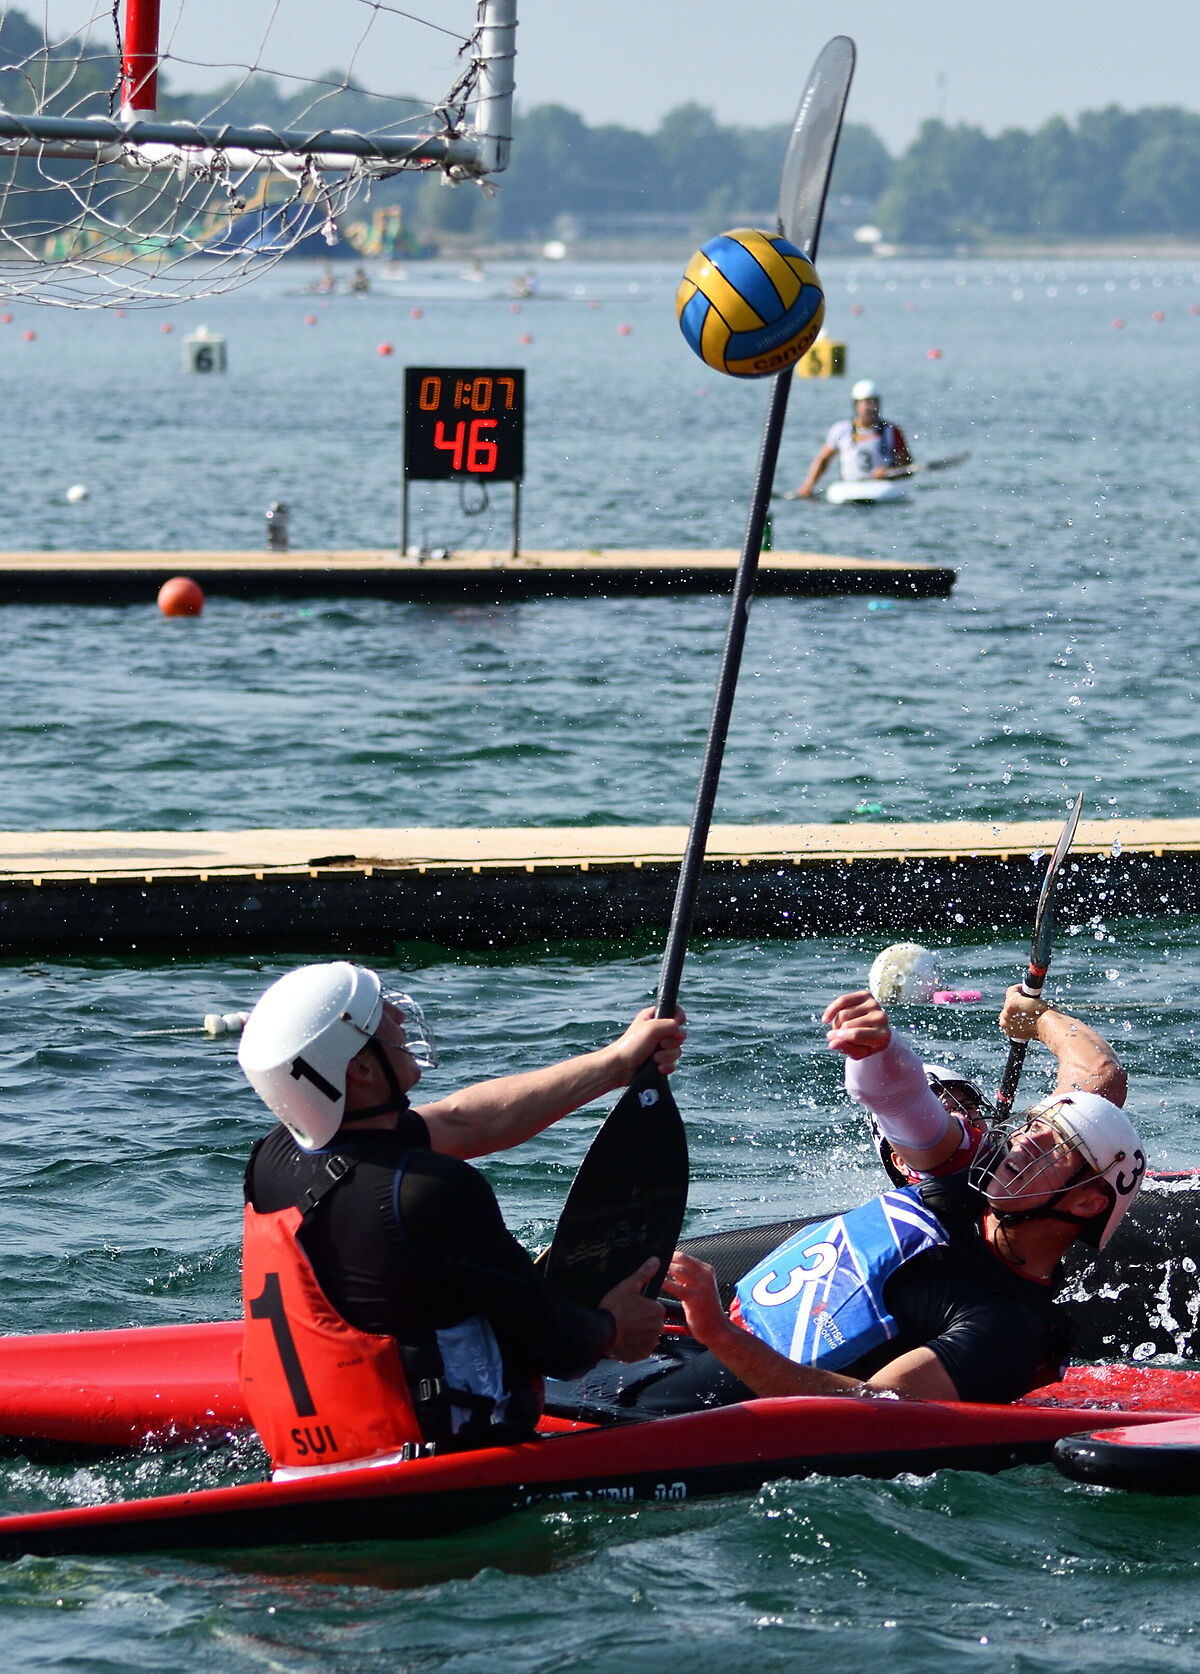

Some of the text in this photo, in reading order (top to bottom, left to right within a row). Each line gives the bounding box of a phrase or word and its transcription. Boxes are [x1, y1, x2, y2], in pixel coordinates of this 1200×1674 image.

[195, 347, 213, 374] 6
[418, 376, 515, 411] 01:07
[433, 418, 498, 473] 46
[290, 1056, 343, 1103] 1
[1115, 1149, 1145, 1196] 3
[752, 1241, 839, 1307] 3
[249, 1272, 317, 1418] 1
[818, 1310, 846, 1346] BRITISH
[291, 1425, 339, 1457] SUI
